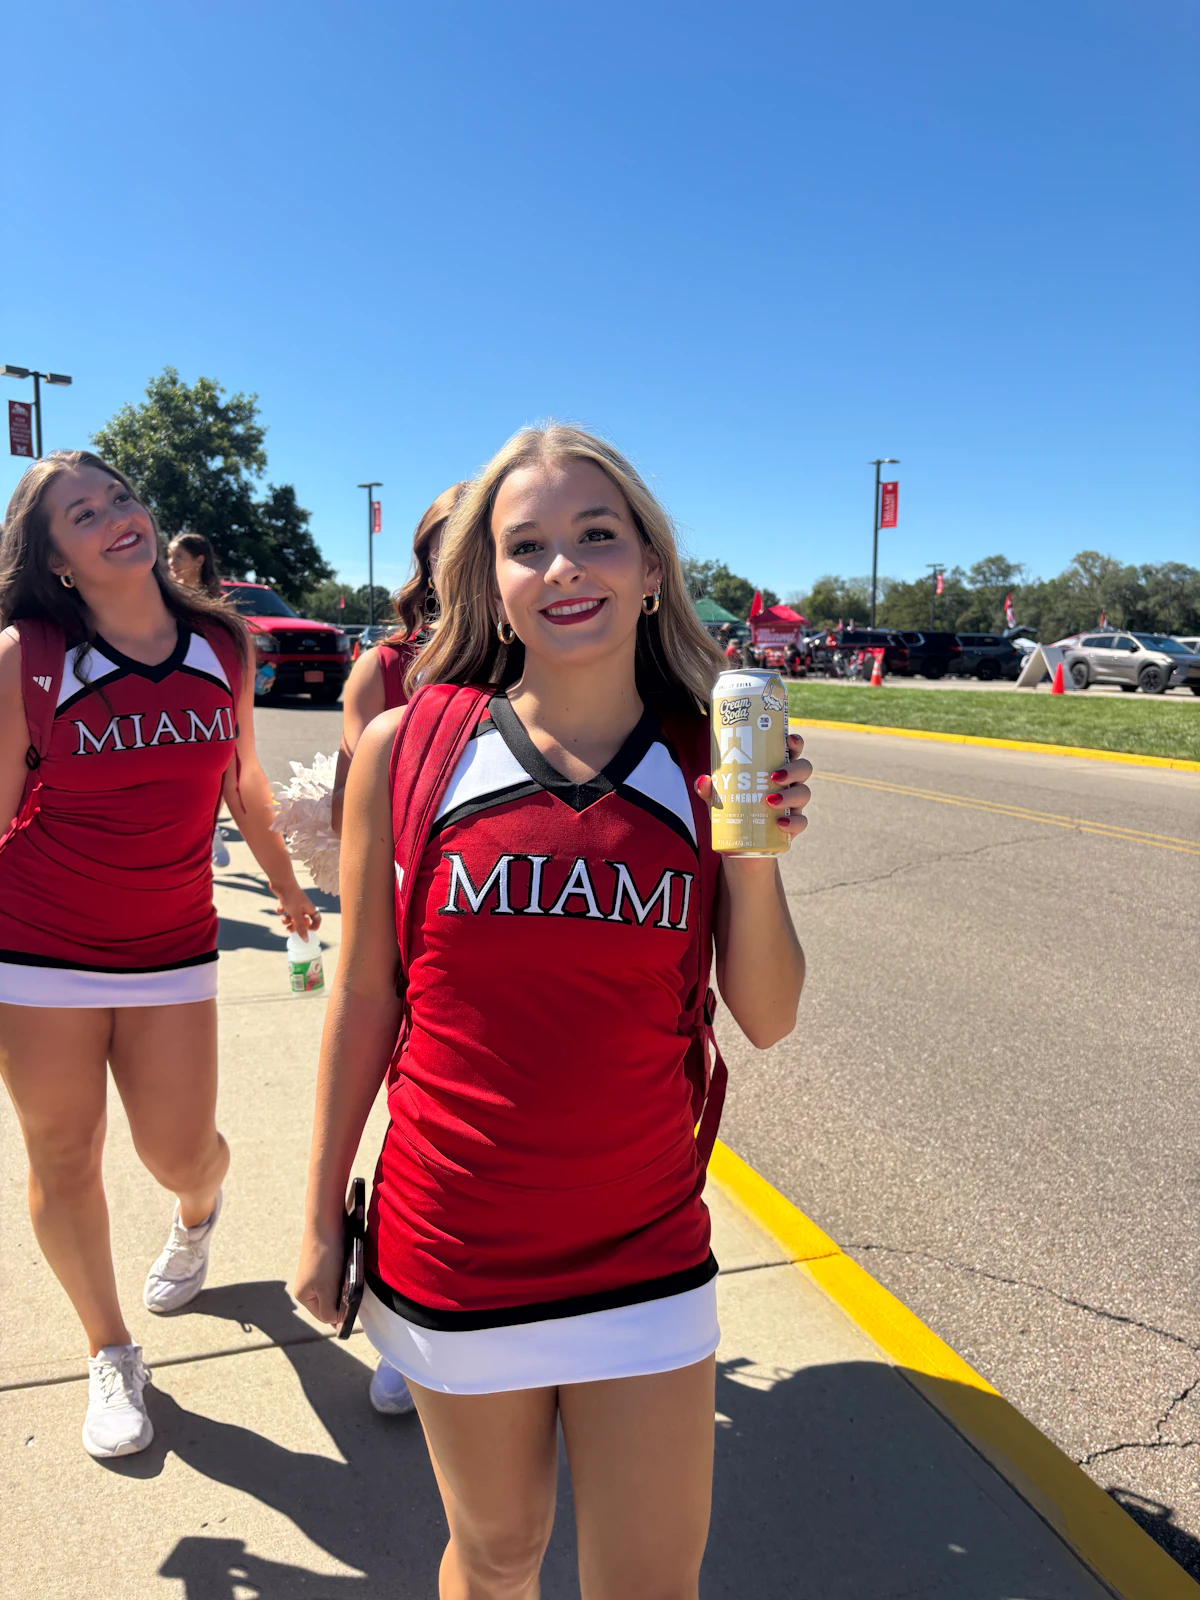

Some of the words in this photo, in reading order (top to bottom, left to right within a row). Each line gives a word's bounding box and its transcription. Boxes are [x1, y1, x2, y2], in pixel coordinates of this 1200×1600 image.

[720, 697, 751, 715] Cream
[722, 708, 749, 725] Soda
[70, 707, 236, 755] MIAMI
[711, 771, 769, 791] RYSE
[730, 792, 764, 803] ENERGY
[438, 852, 695, 932] MIAMI
